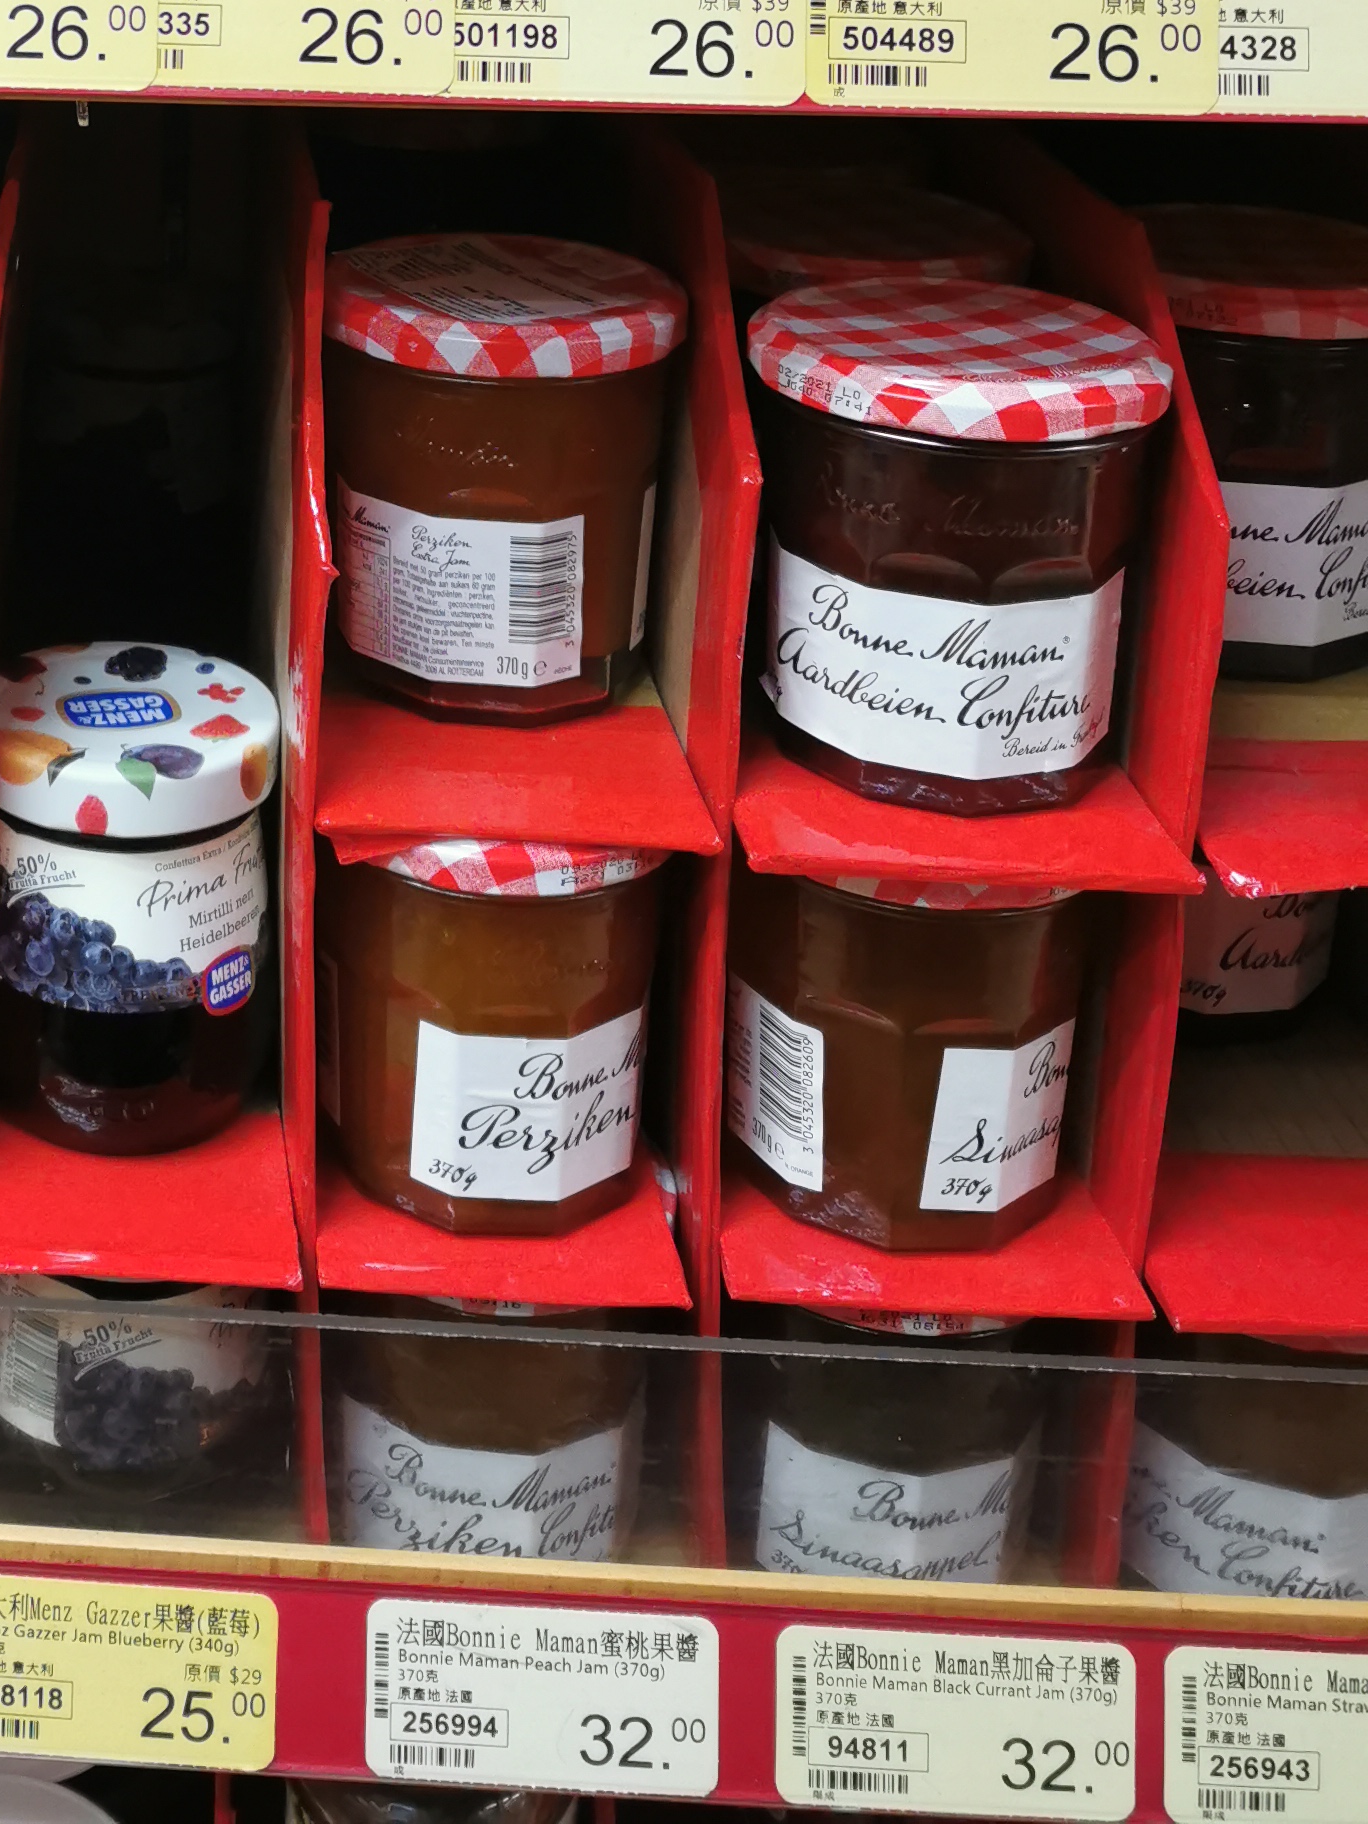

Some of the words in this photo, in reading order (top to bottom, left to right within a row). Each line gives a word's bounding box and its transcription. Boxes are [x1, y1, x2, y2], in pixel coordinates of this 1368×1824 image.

[454, 22, 558, 49] 501198
[843, 27, 954, 52] 504489
[809, 584, 913, 657] Bonne
[777, 628, 946, 724] Aardbeien
[17, 853, 57, 876] 50%
[137, 872, 227, 917] Prima
[209, 973, 252, 1006] GASSER
[514, 1053, 608, 1101] Bonne
[14, 1625, 67, 1642] Gazzer
[73, 1629, 103, 1645] Jam
[108, 1632, 184, 1653] Blueberry
[398, 1649, 453, 1666] Bonnie
[459, 1652, 520, 1670] Maman
[525, 1657, 571, 1673] Peach
[577, 1660, 609, 1676] Jam
[816, 1672, 867, 1689] Bonnie
[872, 1677, 928, 1693] Maman
[933, 1680, 971, 1696] Black
[976, 1682, 1031, 1699] Currant
[1036, 1686, 1065, 1700] Jam
[403, 1712, 498, 1738] 256994
[828, 1736, 909, 1762] 94811
[1210, 1755, 1310, 1781] 256943
